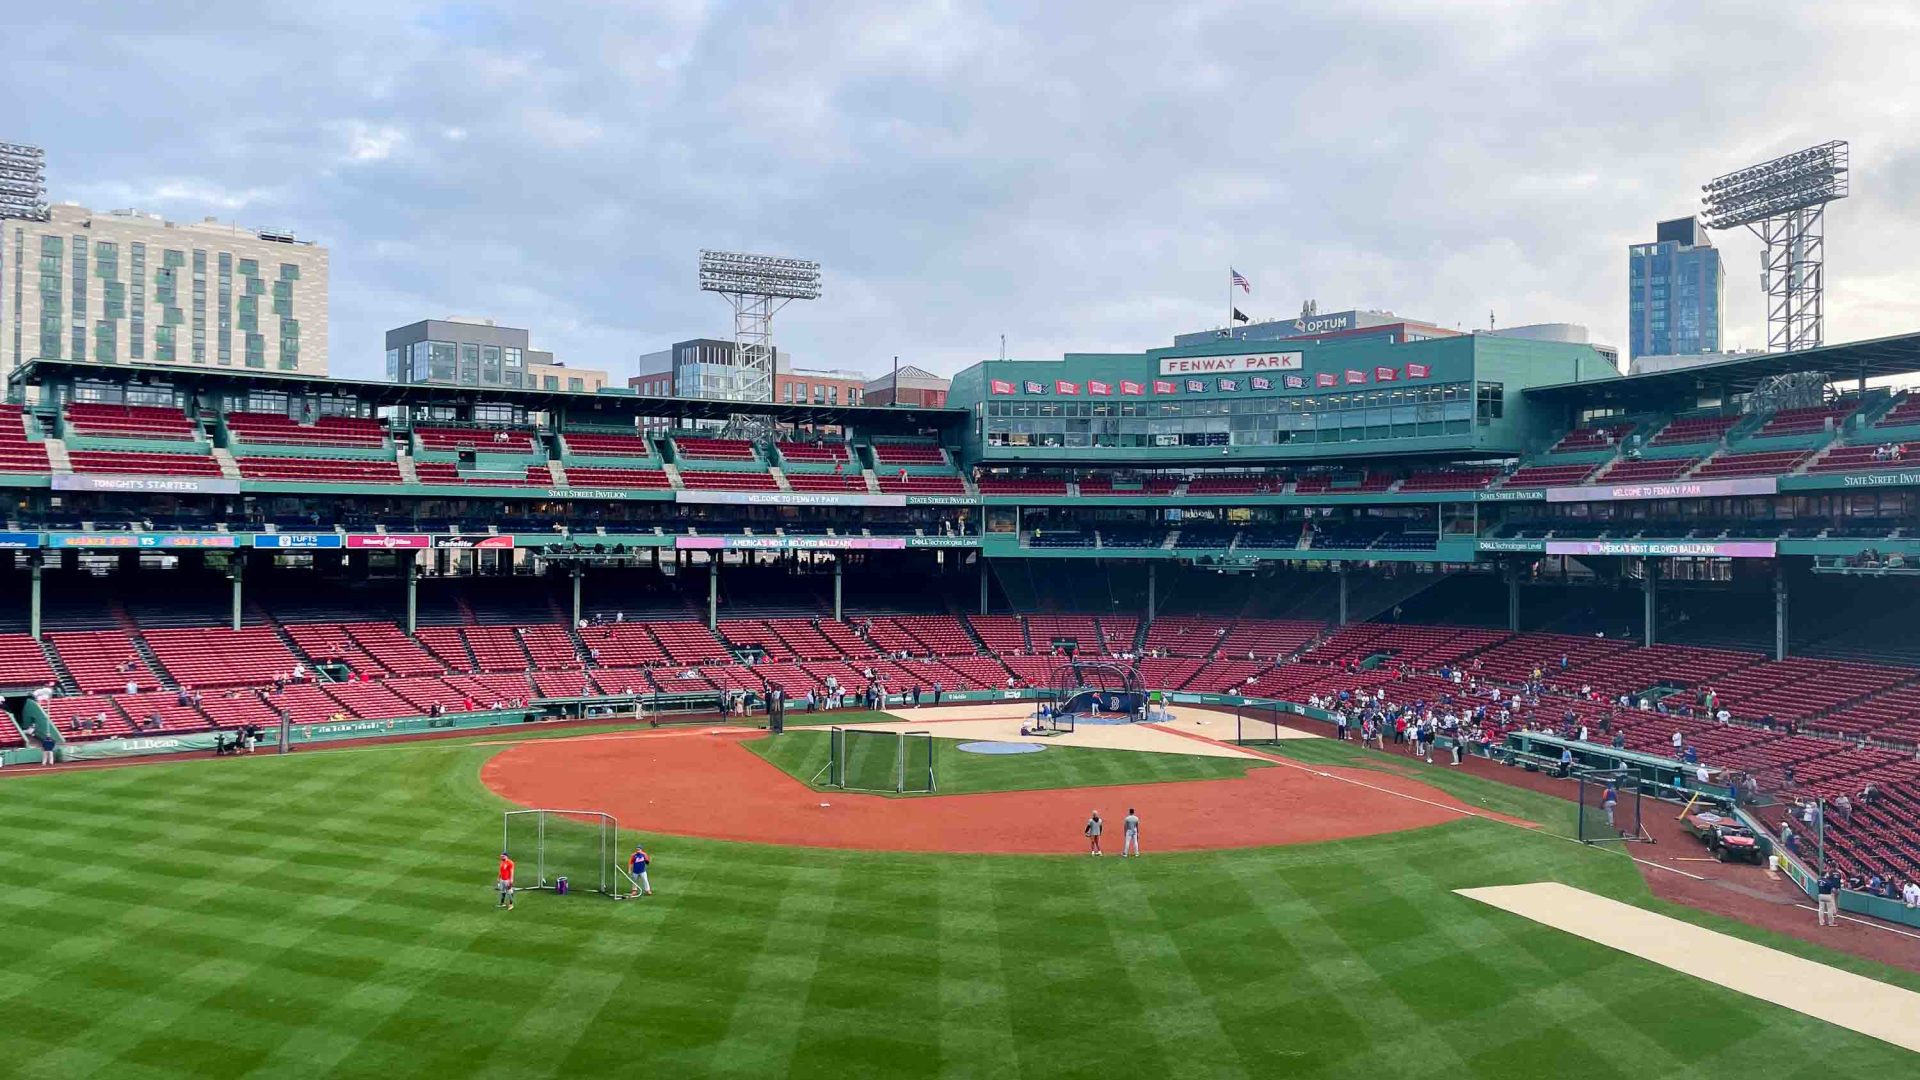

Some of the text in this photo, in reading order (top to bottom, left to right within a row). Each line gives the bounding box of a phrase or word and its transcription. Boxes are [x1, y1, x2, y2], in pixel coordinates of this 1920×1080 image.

[1307, 317, 1347, 332] OPTUM
[1169, 356, 1292, 372] FENWAY PARK
[92, 479, 198, 490] TONIGHT'S STARTERS
[1844, 476, 1867, 486] STATE
[1868, 474, 1898, 484] STREET
[595, 490, 627, 498] PAVILION
[1496, 492, 1515, 500] STREET
[1516, 491, 1543, 499] PAVILION
[1612, 485, 1701, 496] WELCOME TO FENWAY PARK
[928, 496, 949, 504] STREET
[818, 539, 852, 547] BALLPARK
[1599, 544, 1715, 553] AMERICA'S MOST BELOVED BALLPARK
[1110, 697, 1120, 711] B
